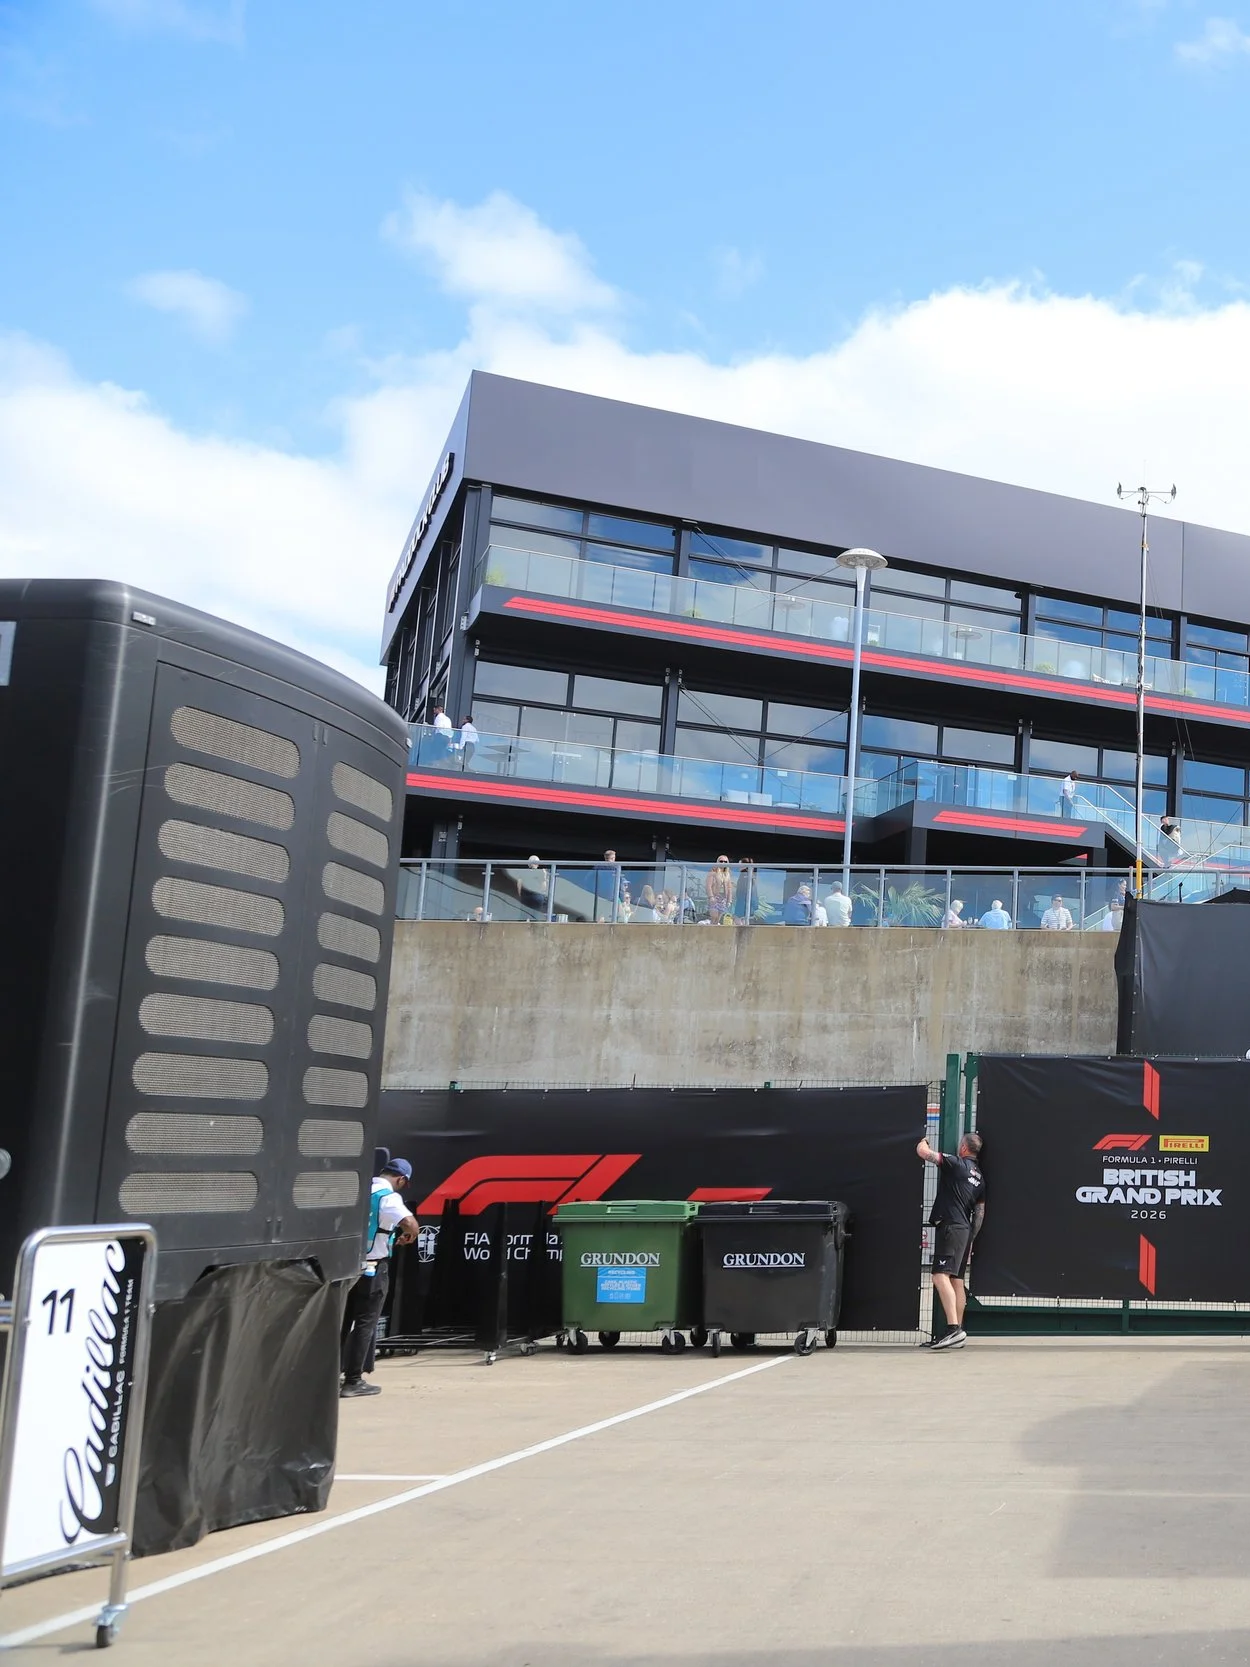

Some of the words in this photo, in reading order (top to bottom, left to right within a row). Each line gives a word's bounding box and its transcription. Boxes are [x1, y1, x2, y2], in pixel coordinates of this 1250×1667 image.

[1163, 1138, 1205, 1149] PIRELLI
[1102, 1155, 1148, 1164] FORMULA
[1150, 1156, 1157, 1164] 1
[1163, 1157, 1198, 1165] PIRELLI
[1103, 1168, 1196, 1187] BRITISH
[1075, 1186, 1162, 1205] GRAND
[1165, 1188, 1223, 1206] PRIX
[1130, 1209, 1167, 1220] 2026
[464, 1232, 491, 1245] FIA
[580, 1252, 661, 1265] GRUNDON
[723, 1252, 806, 1266] GRUNDON
[42, 1288, 75, 1336] 11
[59, 1243, 126, 1545] Cadillac
